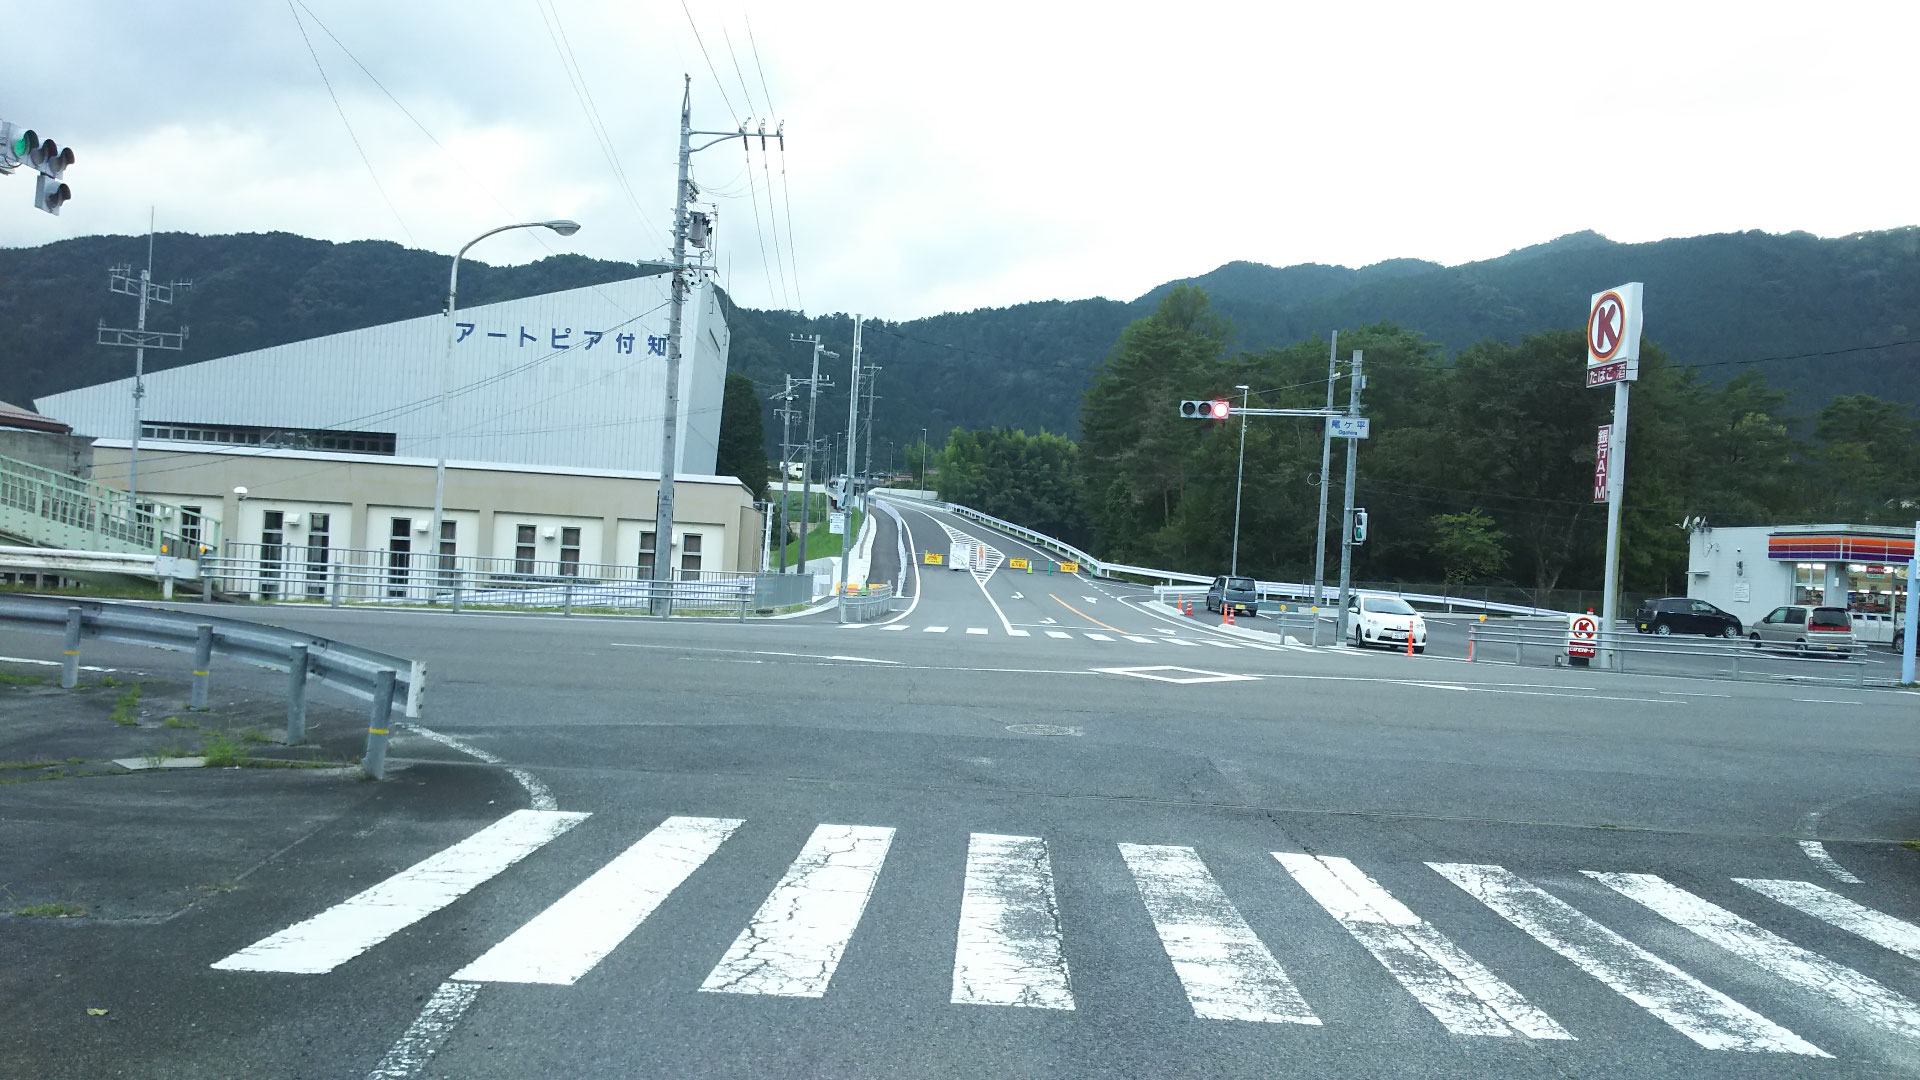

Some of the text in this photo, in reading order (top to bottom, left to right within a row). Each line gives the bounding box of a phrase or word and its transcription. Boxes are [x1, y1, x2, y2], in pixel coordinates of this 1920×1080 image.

[455, 322, 667, 356] アートピア付知
[1589, 367, 1613, 385] たばこ
[1595, 429, 1608, 499] 銀行ATM
